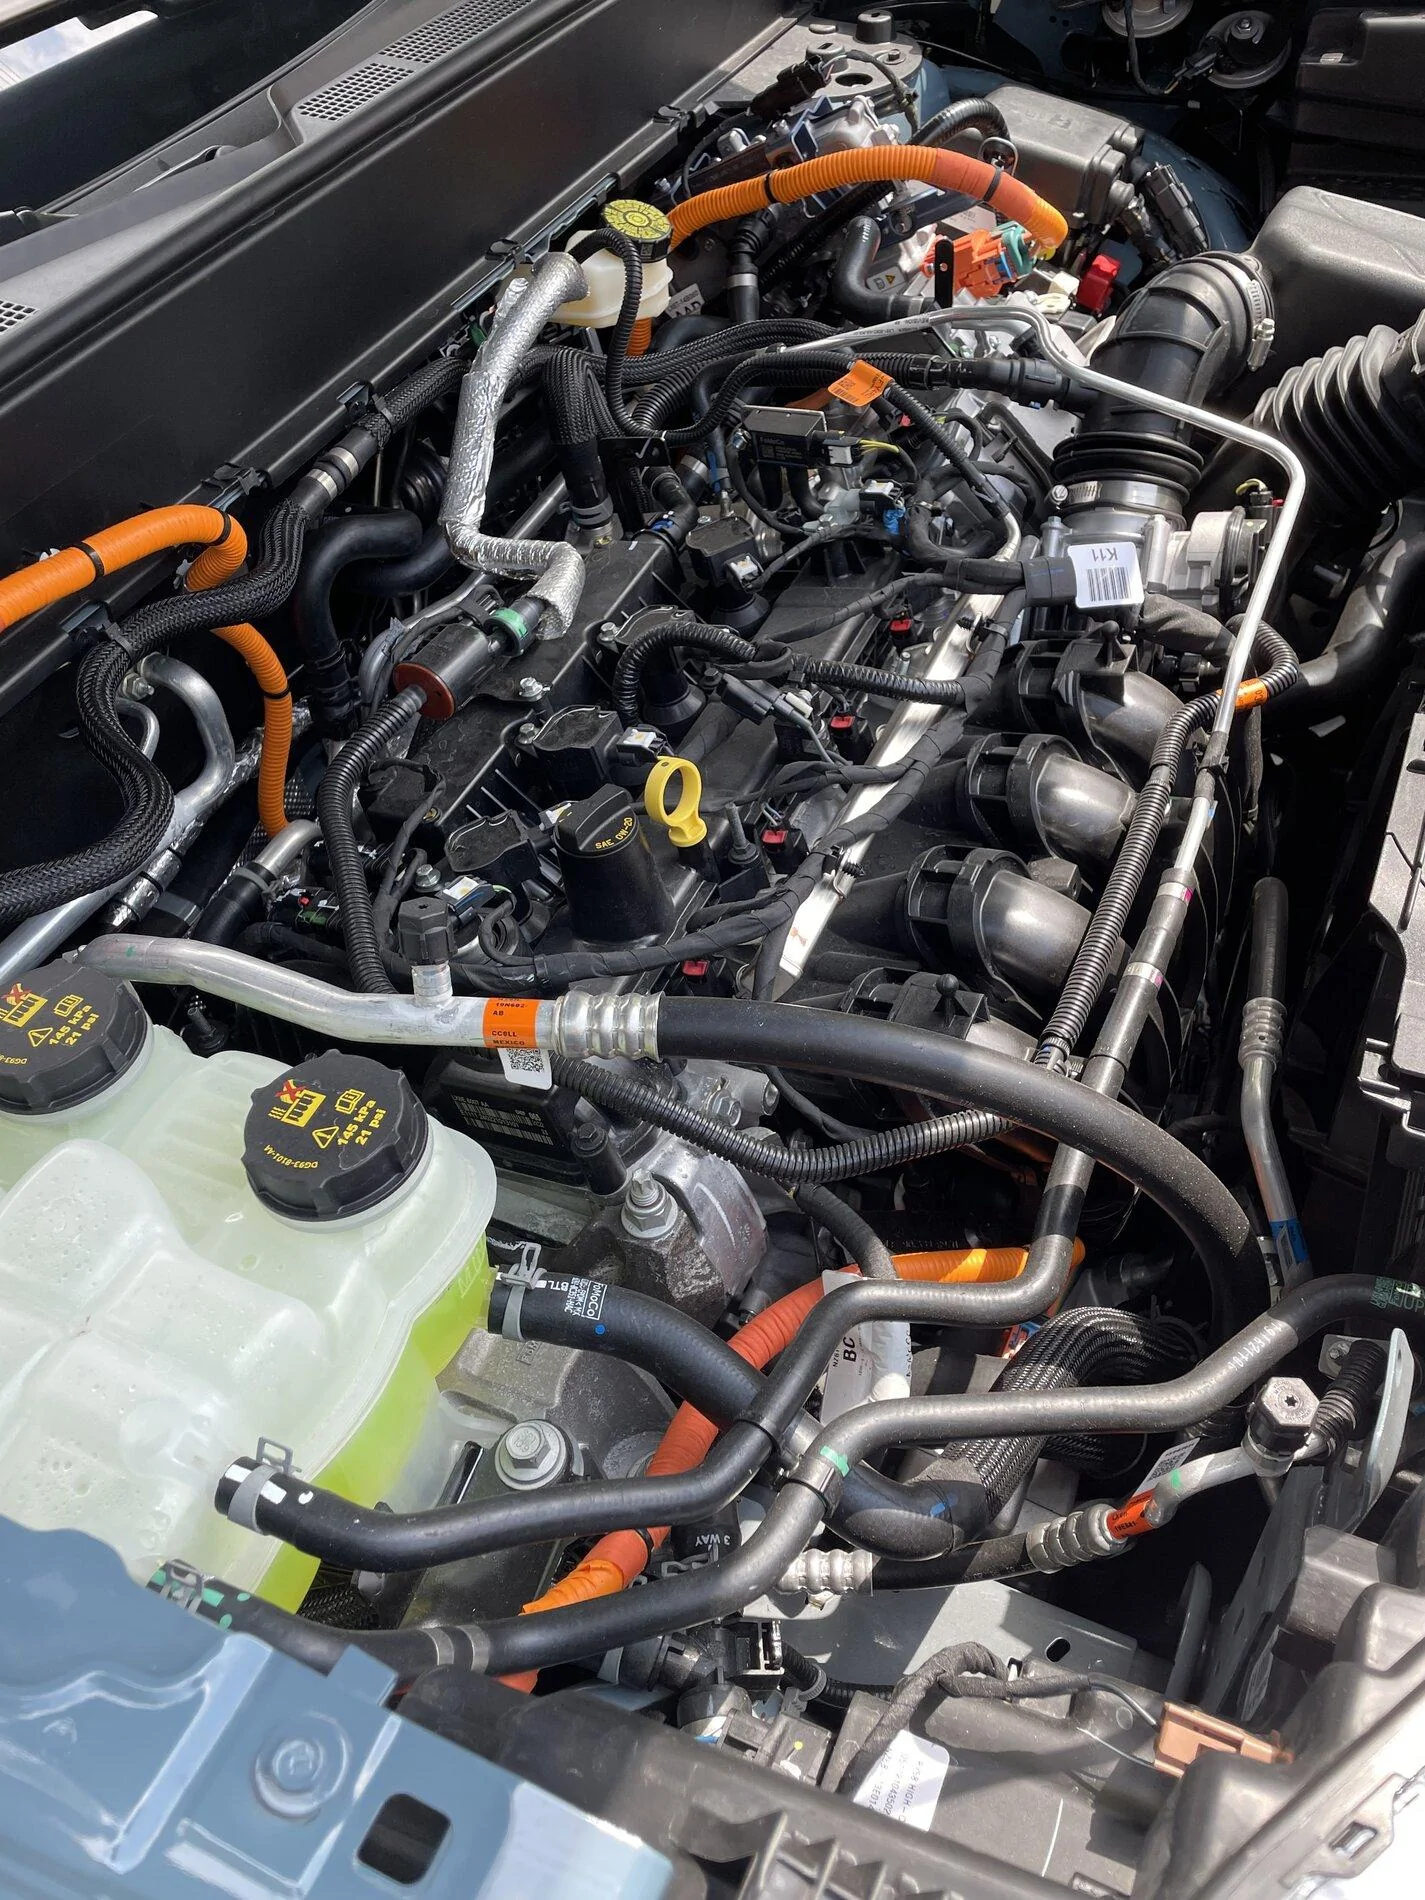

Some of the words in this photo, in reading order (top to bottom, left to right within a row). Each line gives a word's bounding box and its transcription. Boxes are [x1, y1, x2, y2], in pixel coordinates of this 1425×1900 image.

[1091, 547, 1119, 562] K11
[594, 838, 615, 850] SAE
[614, 816, 634, 841] 0W-20
[48, 1025, 72, 1046] 145
[67, 1004, 93, 1026] kPa
[64, 1031, 82, 1046] 21
[80, 1012, 100, 1031] psi
[336, 1123, 359, 1147] 145
[353, 1099, 377, 1122] kPa
[354, 1129, 373, 1146] 21
[368, 1108, 388, 1129] psi
[263, 1144, 319, 1169] DG93-8101-AA
[546, 1279, 570, 1292] BTL
[586, 1280, 602, 1318] FoMoCo
[842, 1336, 858, 1363] BC
[694, 1533, 721, 1548] WAY
[723, 1534, 731, 1546] 3
